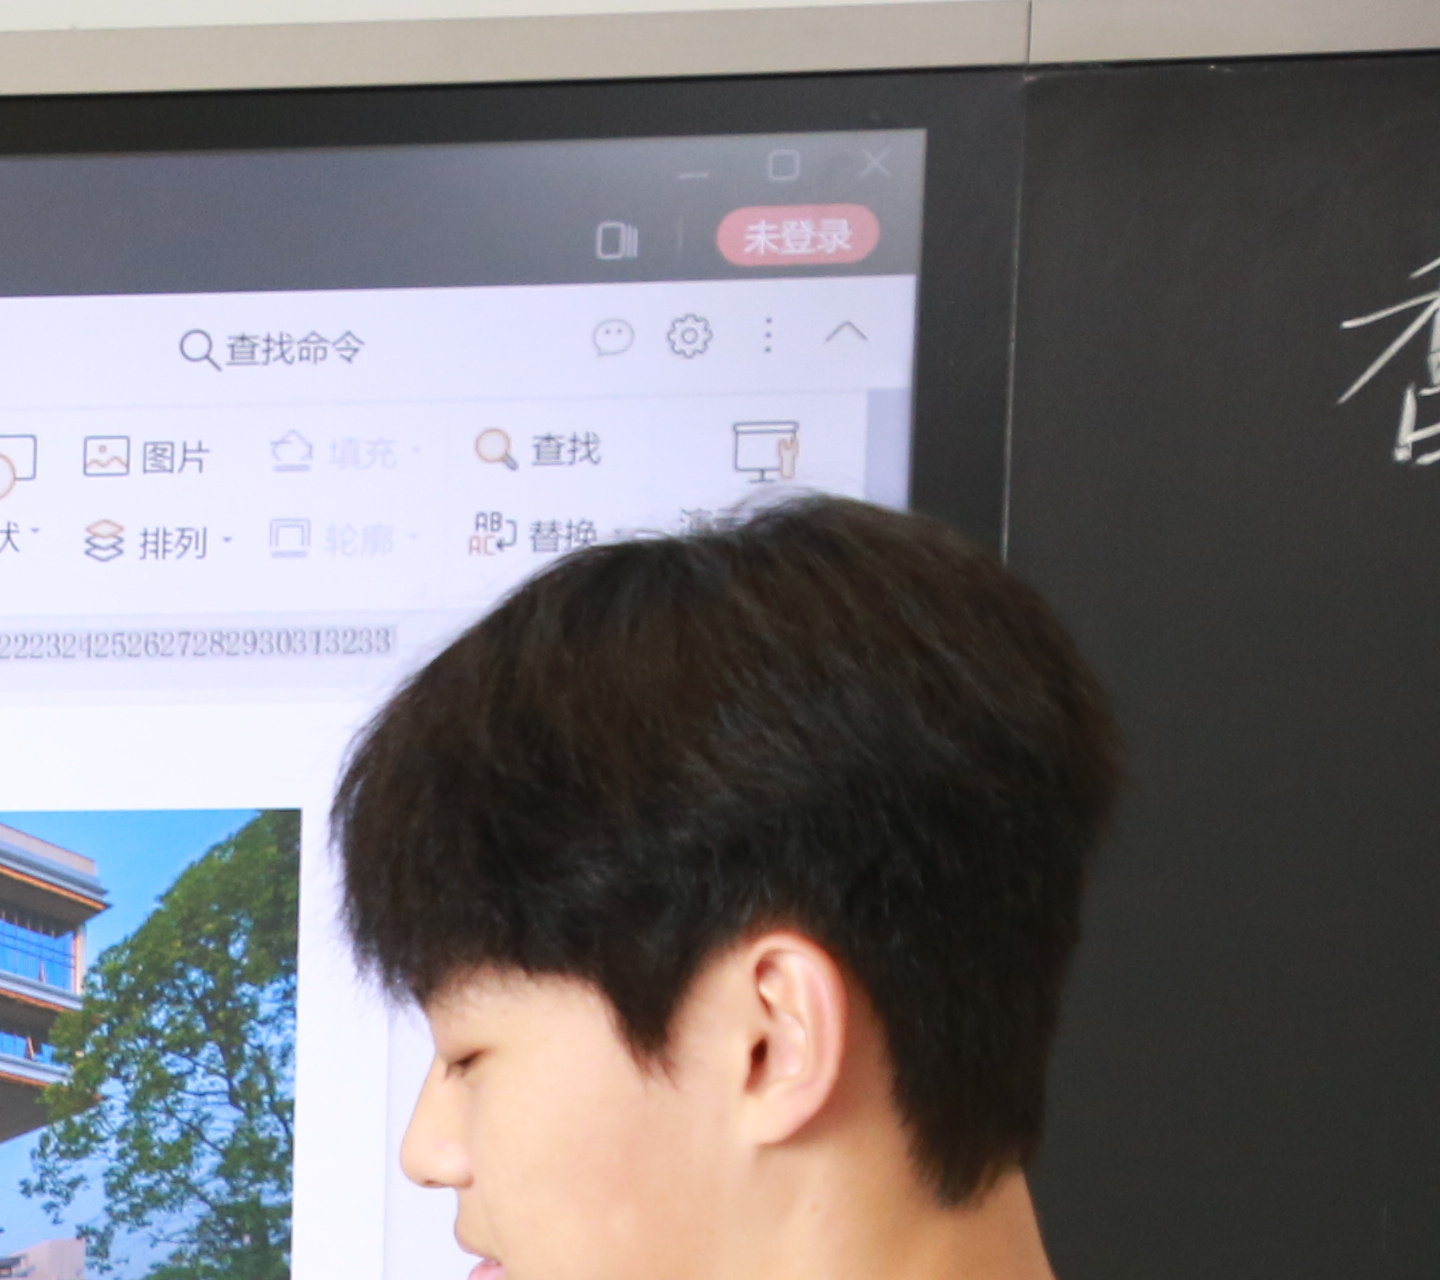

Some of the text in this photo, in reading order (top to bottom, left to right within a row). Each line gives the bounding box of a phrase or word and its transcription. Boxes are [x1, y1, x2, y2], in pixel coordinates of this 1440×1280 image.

[743, 219, 854, 256] 未登录
[225, 329, 366, 367] 查找命令
[142, 440, 211, 475] 图片
[531, 430, 602, 467] 查找
[138, 525, 208, 560] 排列
[529, 518, 598, 553] 替换
